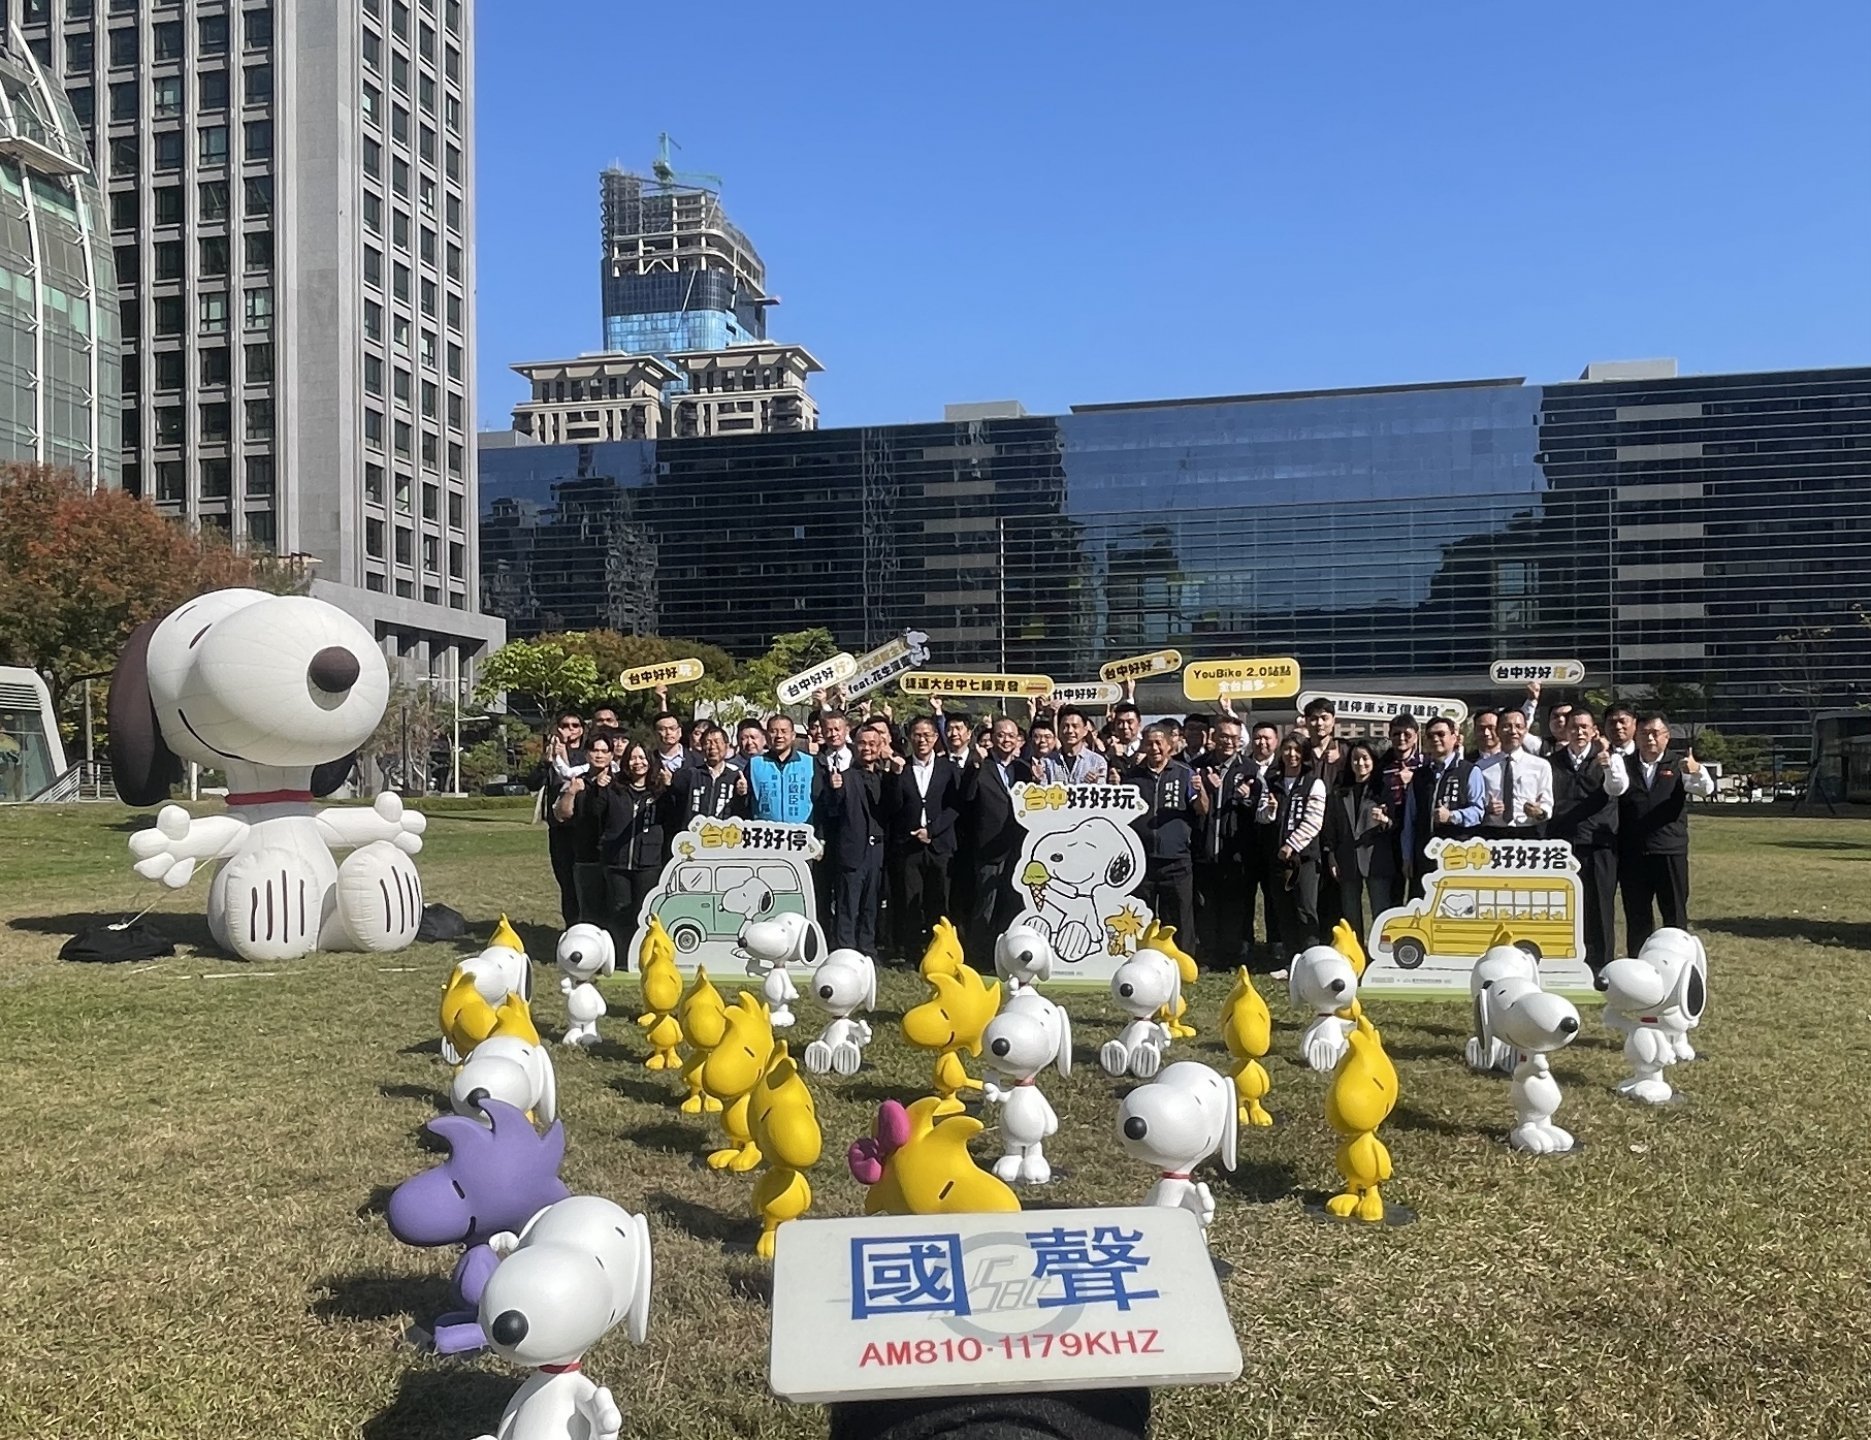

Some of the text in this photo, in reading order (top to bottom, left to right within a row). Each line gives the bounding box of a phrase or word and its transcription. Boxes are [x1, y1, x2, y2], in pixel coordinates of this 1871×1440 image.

[1193, 668, 1242, 679] YouBike
[1023, 785, 1135, 810] 台中好好玩
[700, 823, 807, 851] 台中好好停
[1441, 843, 1567, 870] 台中好好搭
[851, 1226, 1160, 1319] 國聲
